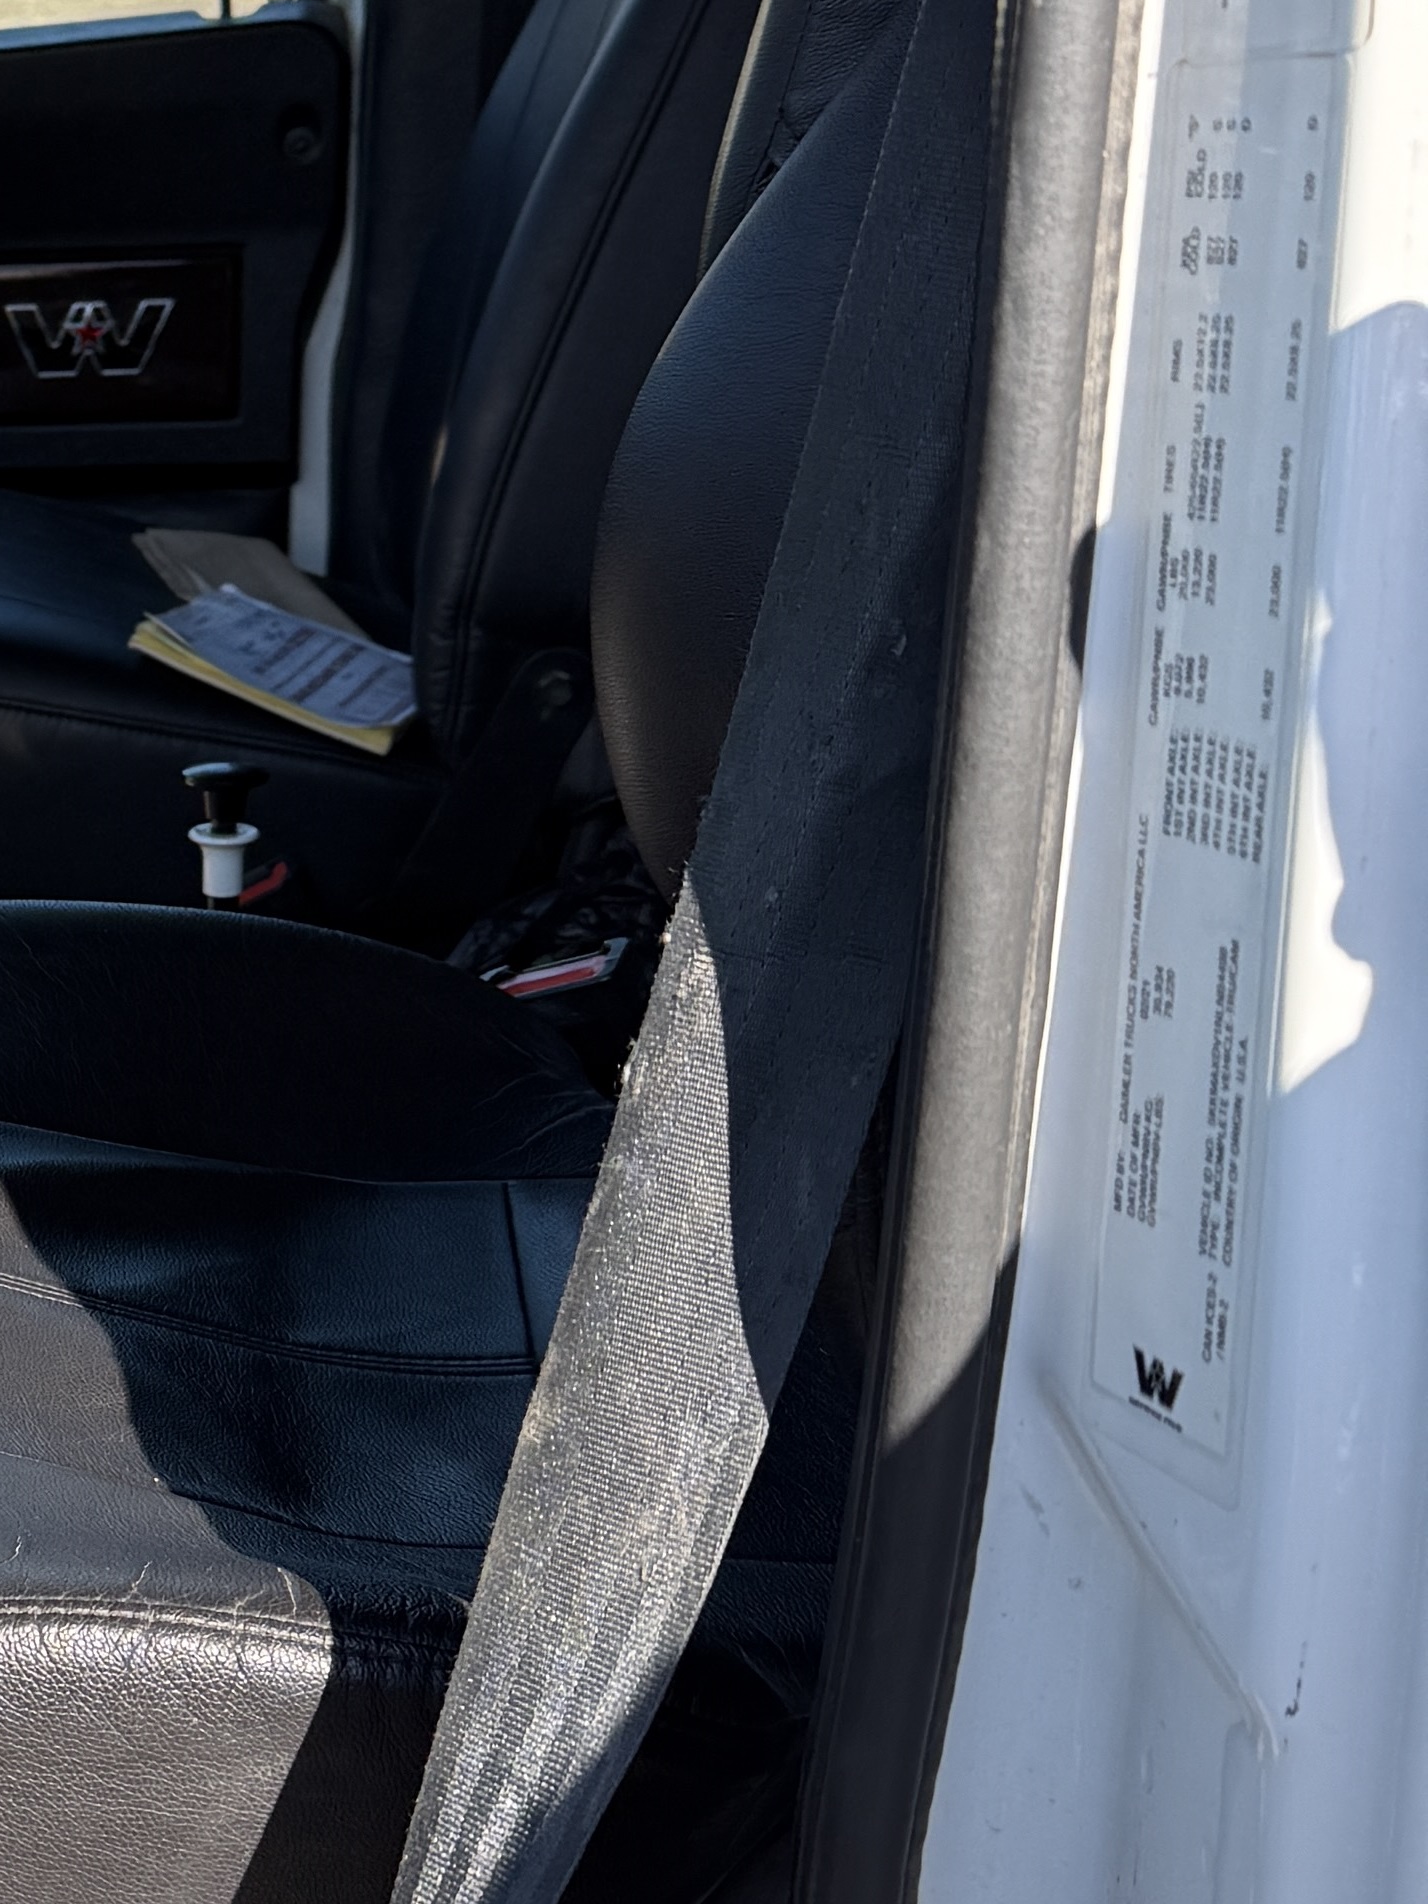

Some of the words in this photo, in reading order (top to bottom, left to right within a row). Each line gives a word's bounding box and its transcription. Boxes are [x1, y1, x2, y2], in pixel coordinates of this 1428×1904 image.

[1137, 813, 1149, 844] LLC
[1125, 1178, 1138, 1218] DATE
[1220, 1188, 1238, 1267] COUNTRY
